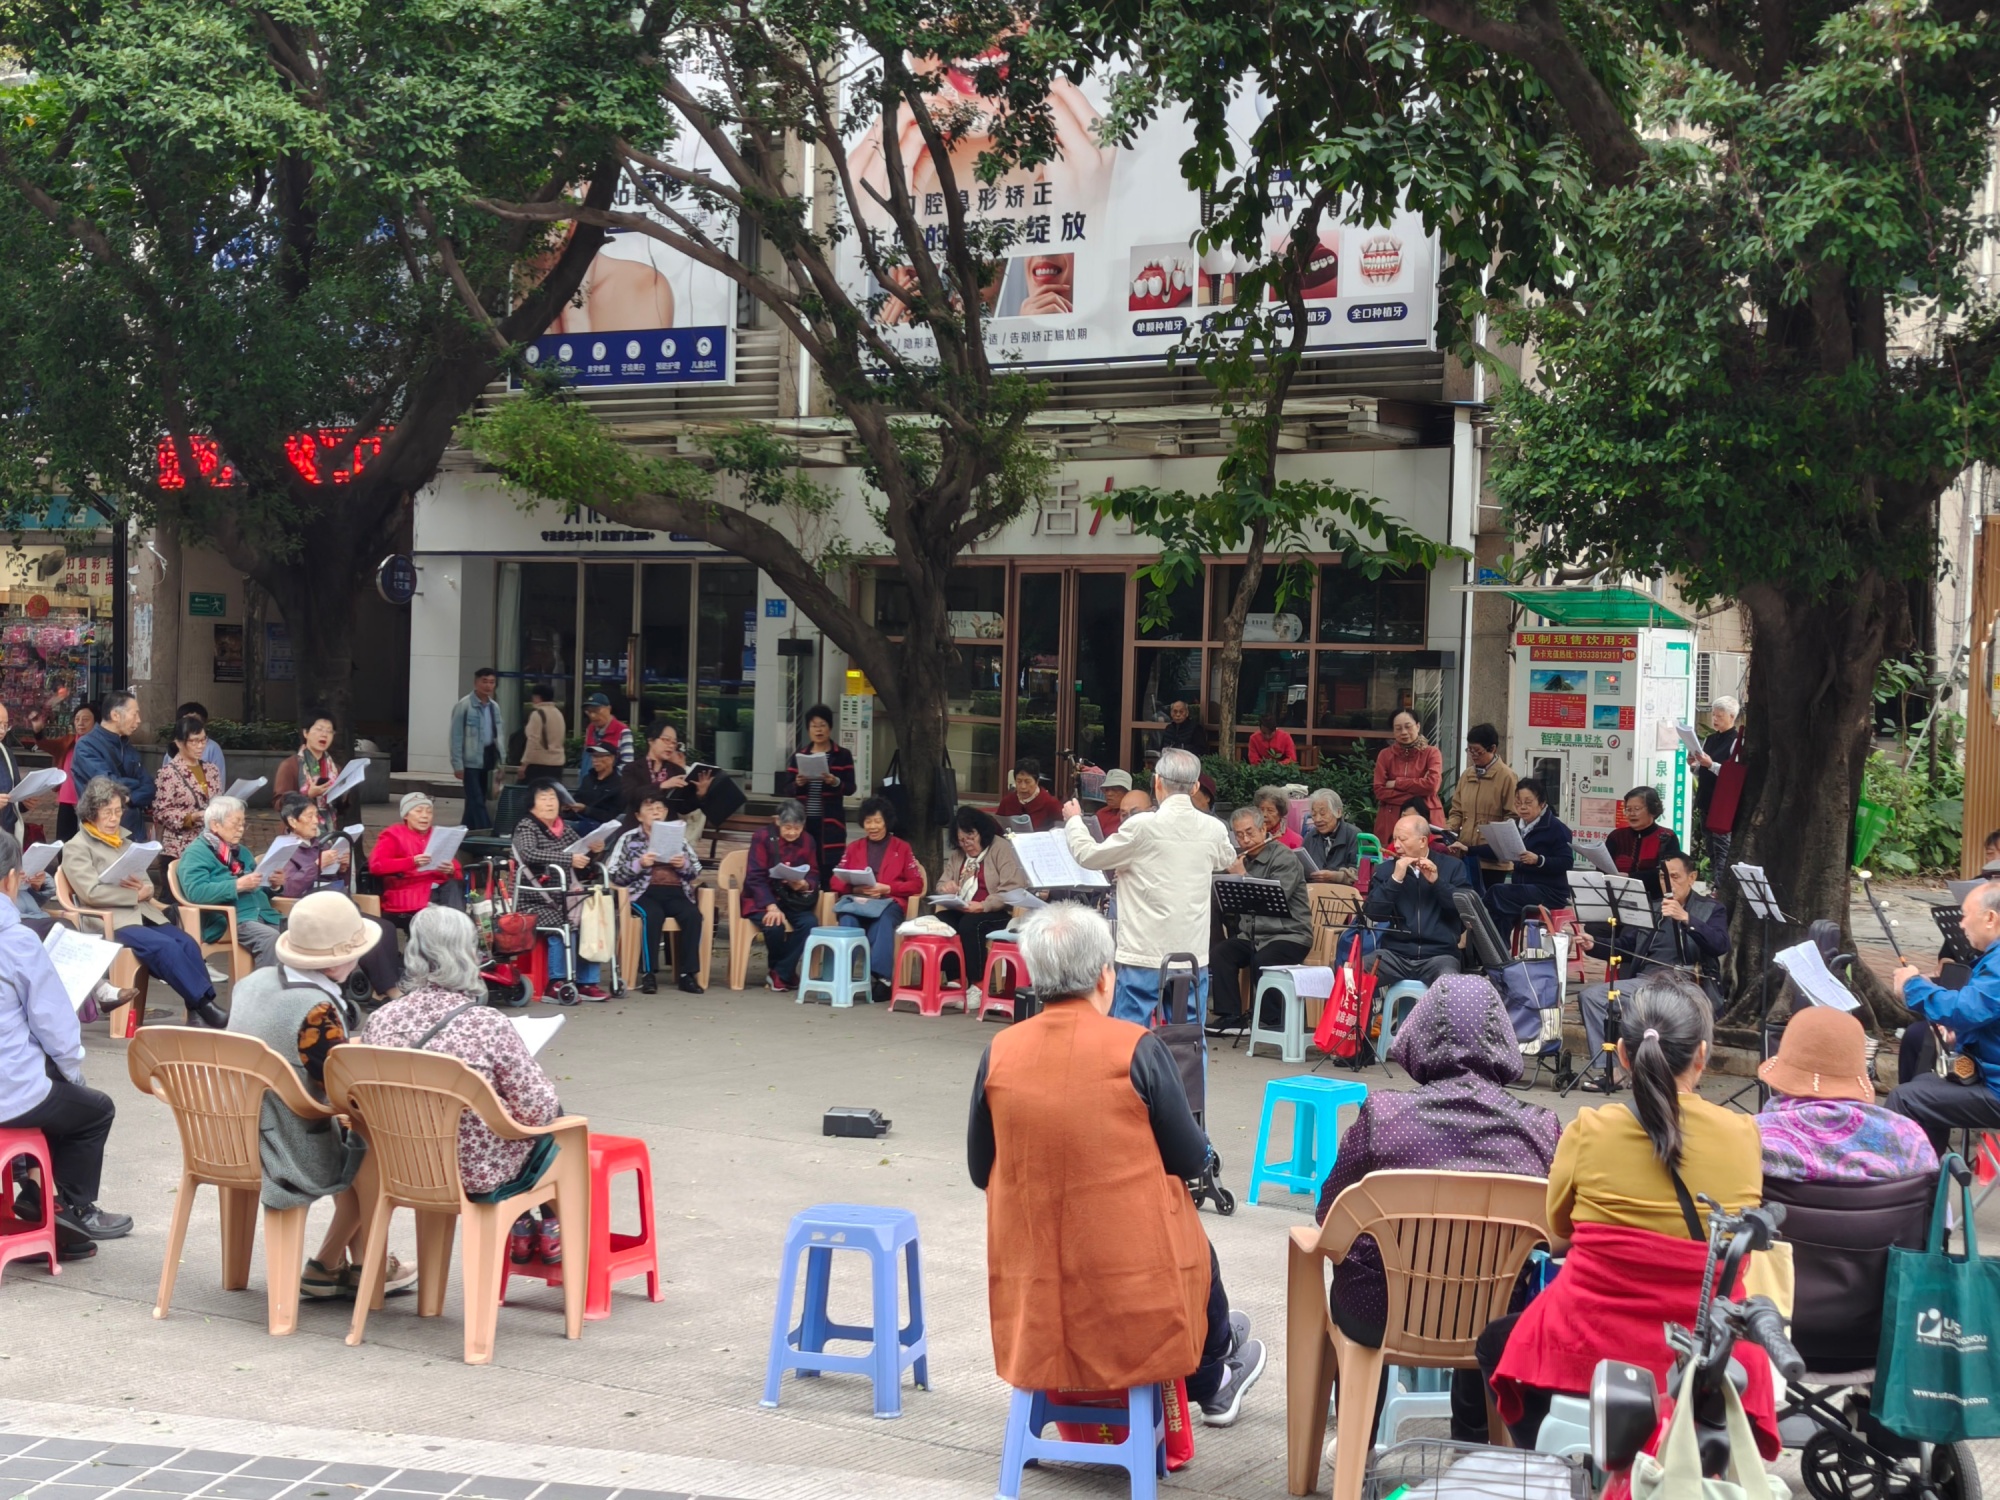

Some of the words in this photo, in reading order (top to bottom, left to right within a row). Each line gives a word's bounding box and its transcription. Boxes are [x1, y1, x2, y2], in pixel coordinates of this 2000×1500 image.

[1351, 306, 1404, 319] 全口种植牙
[1136, 320, 1183, 333] 单颗种植牙
[1010, 328, 1087, 344] 告别矫正尴尬期
[1522, 633, 1633, 646] 现制现售饮用水
[1943, 1317, 1961, 1335] US
